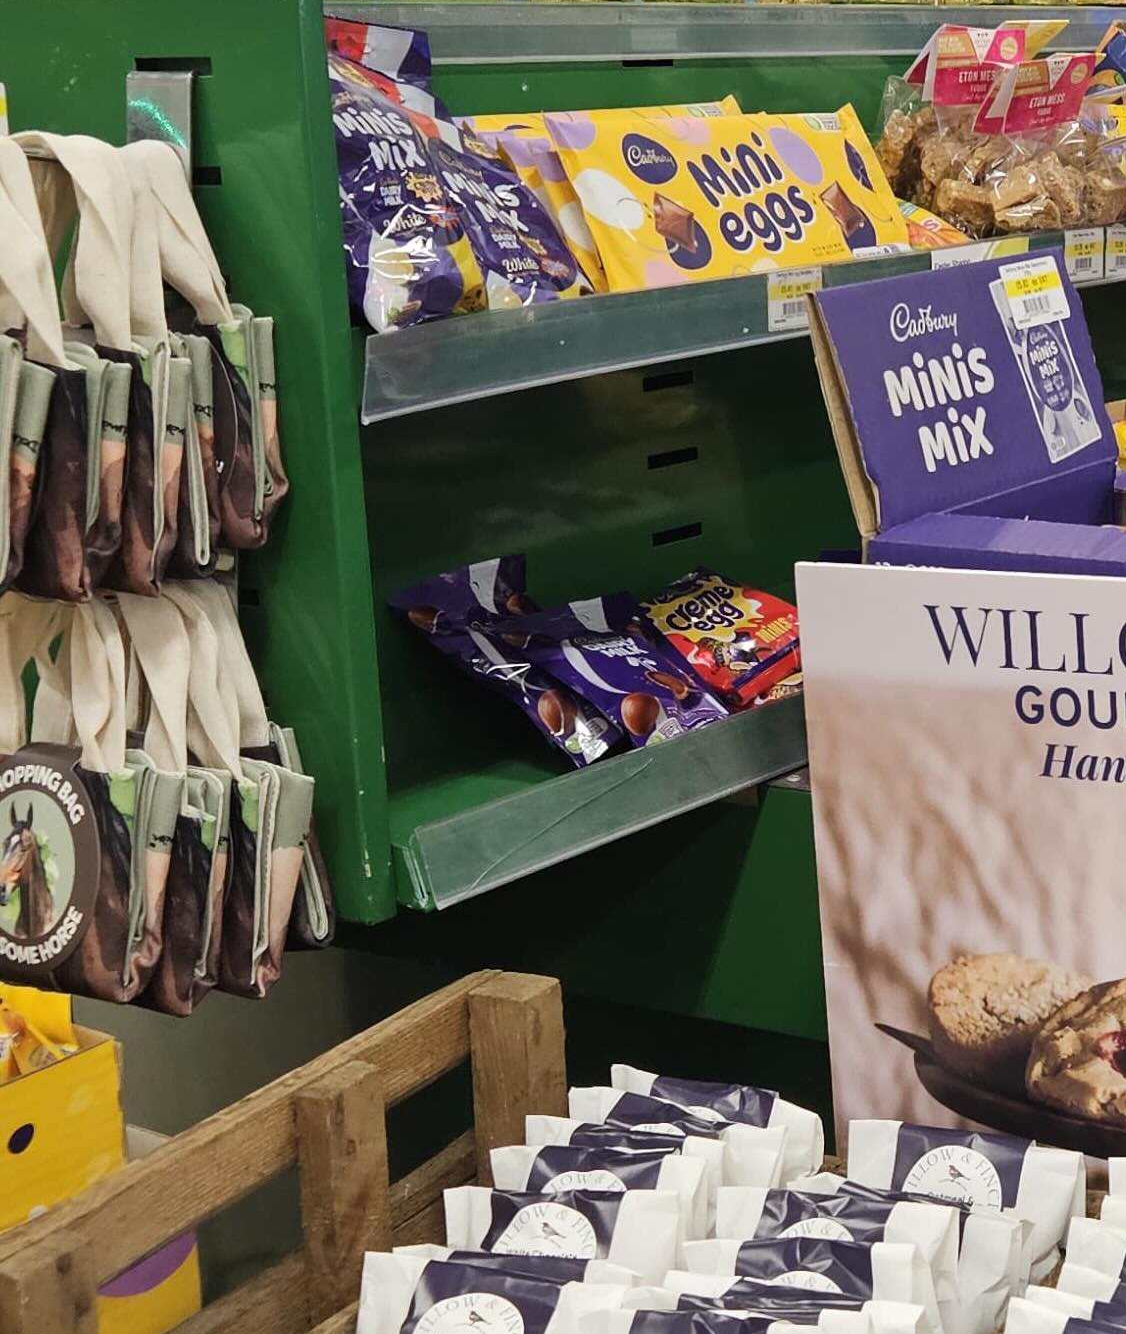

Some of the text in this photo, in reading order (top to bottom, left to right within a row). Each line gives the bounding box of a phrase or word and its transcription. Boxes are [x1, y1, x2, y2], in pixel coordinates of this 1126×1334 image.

[980, 70, 996, 81] MES
[627, 145, 675, 166] Cadbury
[687, 130, 784, 208] Mini
[719, 184, 815, 252] eggs
[890, 303, 958, 342] Cadbury
[697, 602, 744, 633] egg
[0, 765, 85, 825] OPPING BAG
